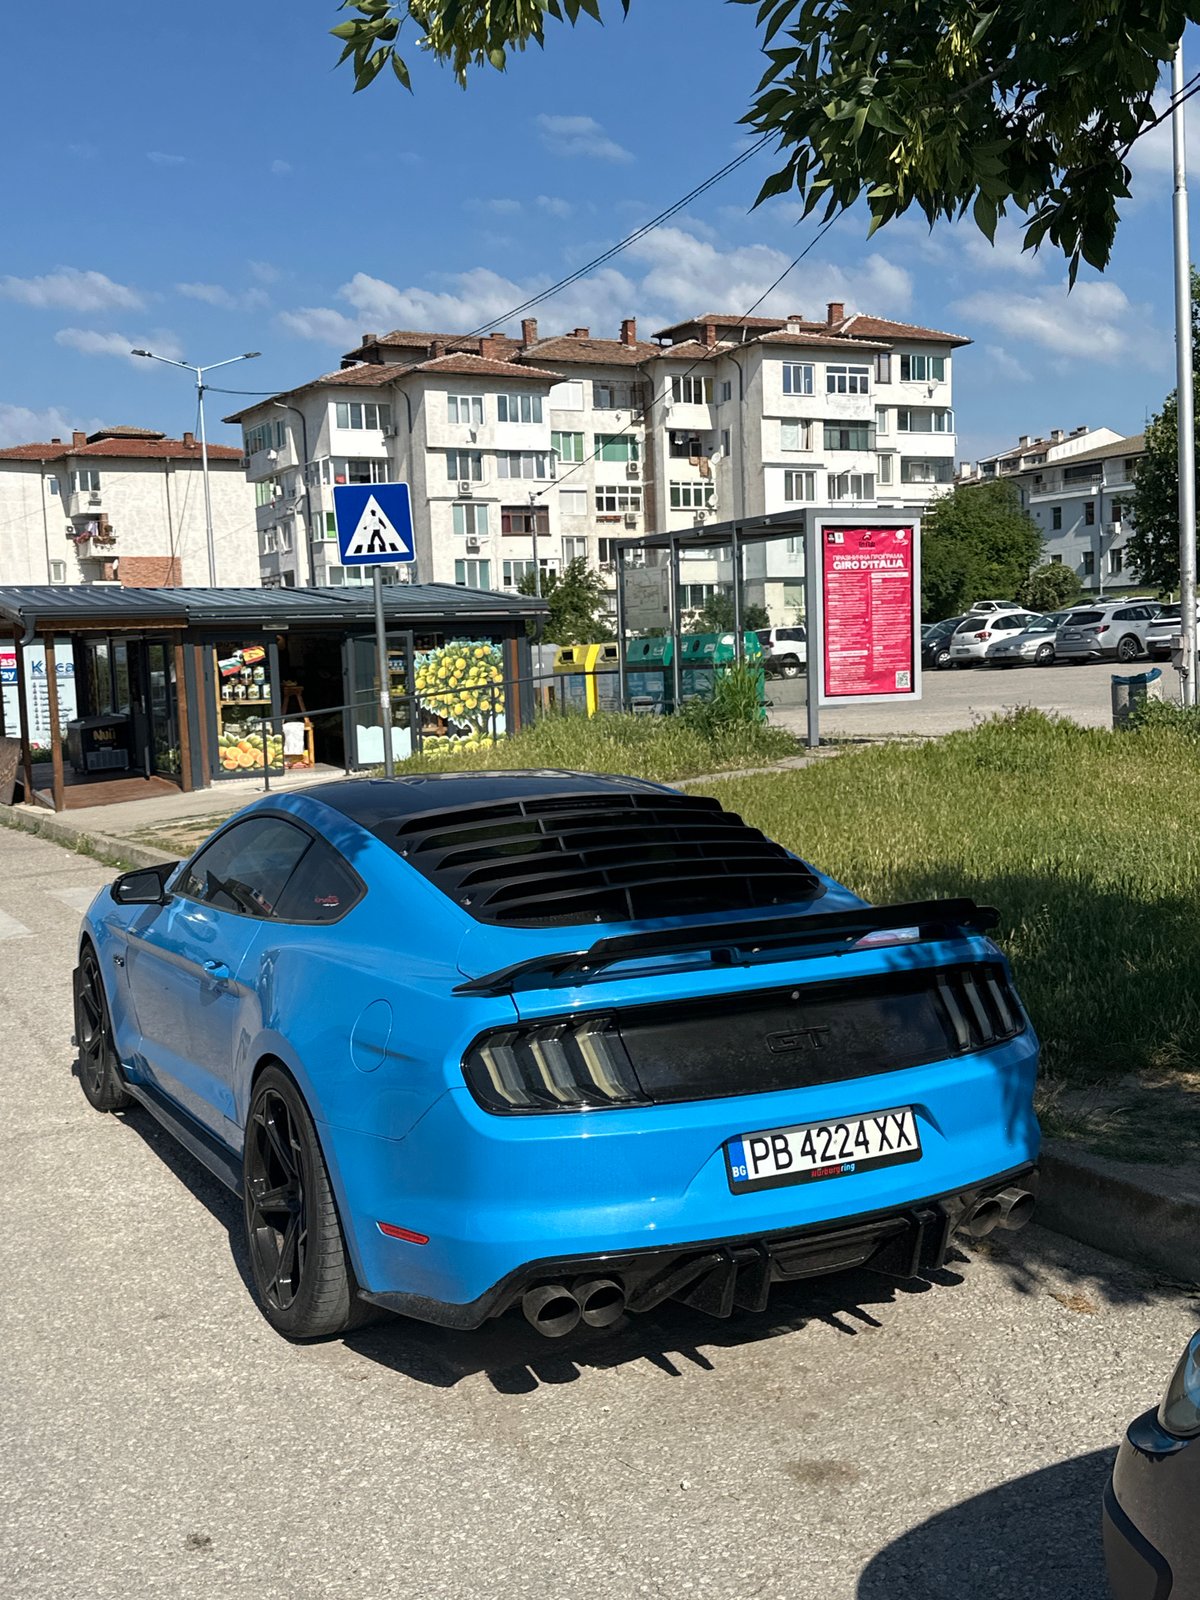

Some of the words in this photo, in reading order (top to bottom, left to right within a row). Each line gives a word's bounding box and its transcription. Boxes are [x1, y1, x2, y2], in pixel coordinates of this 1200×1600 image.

[832, 561, 860, 570] GIRO
[860, 559, 904, 569] D'ITALIA
[766, 1025, 830, 1054] GT
[750, 1134, 793, 1175] PB
[800, 1120, 870, 1164] 4224
[872, 1112, 912, 1152] XX
[732, 1166, 747, 1178] BG
